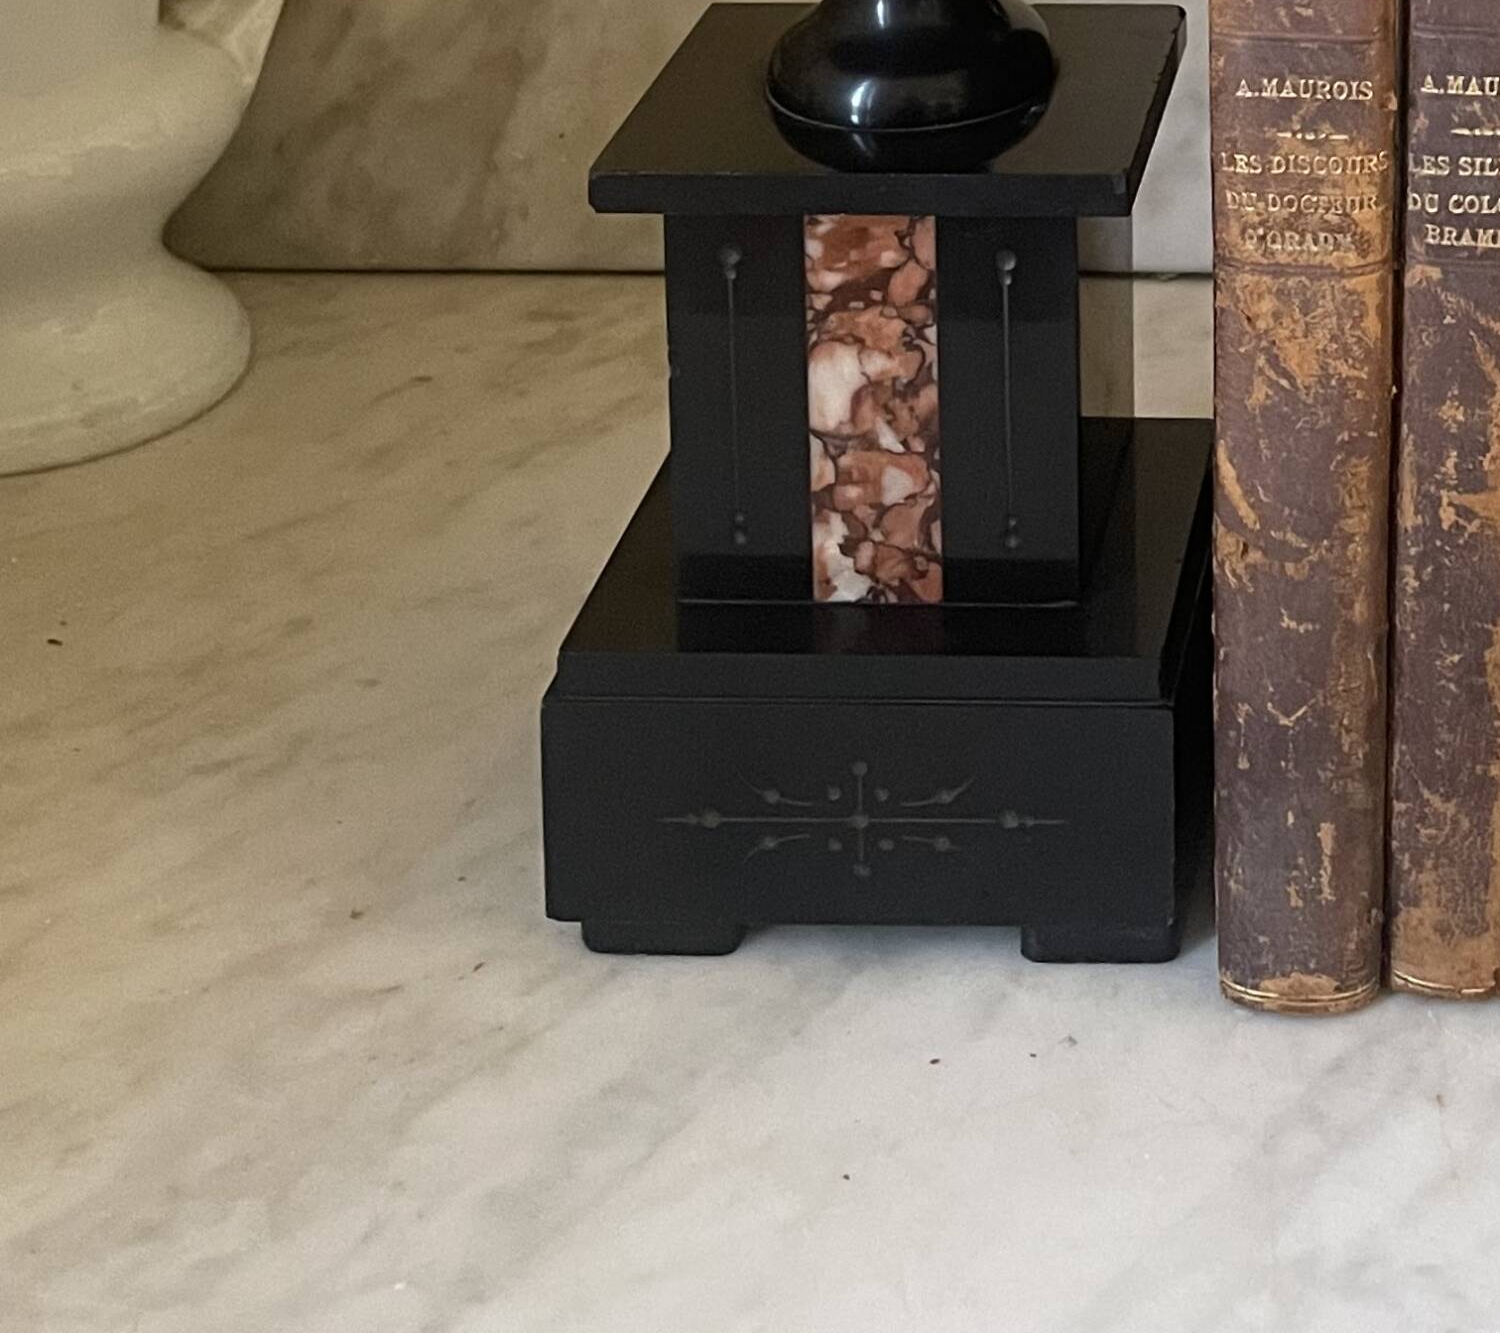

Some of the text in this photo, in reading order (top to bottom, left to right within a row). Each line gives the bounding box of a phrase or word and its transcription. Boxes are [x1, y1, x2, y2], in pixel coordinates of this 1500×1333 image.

[1235, 78, 1373, 101] A.MAUROIS
[1220, 151, 1389, 175] LES DISCOURS
[1408, 153, 1450, 177] LES
[1225, 190, 1258, 212] DU
[1407, 190, 1440, 214] DU
